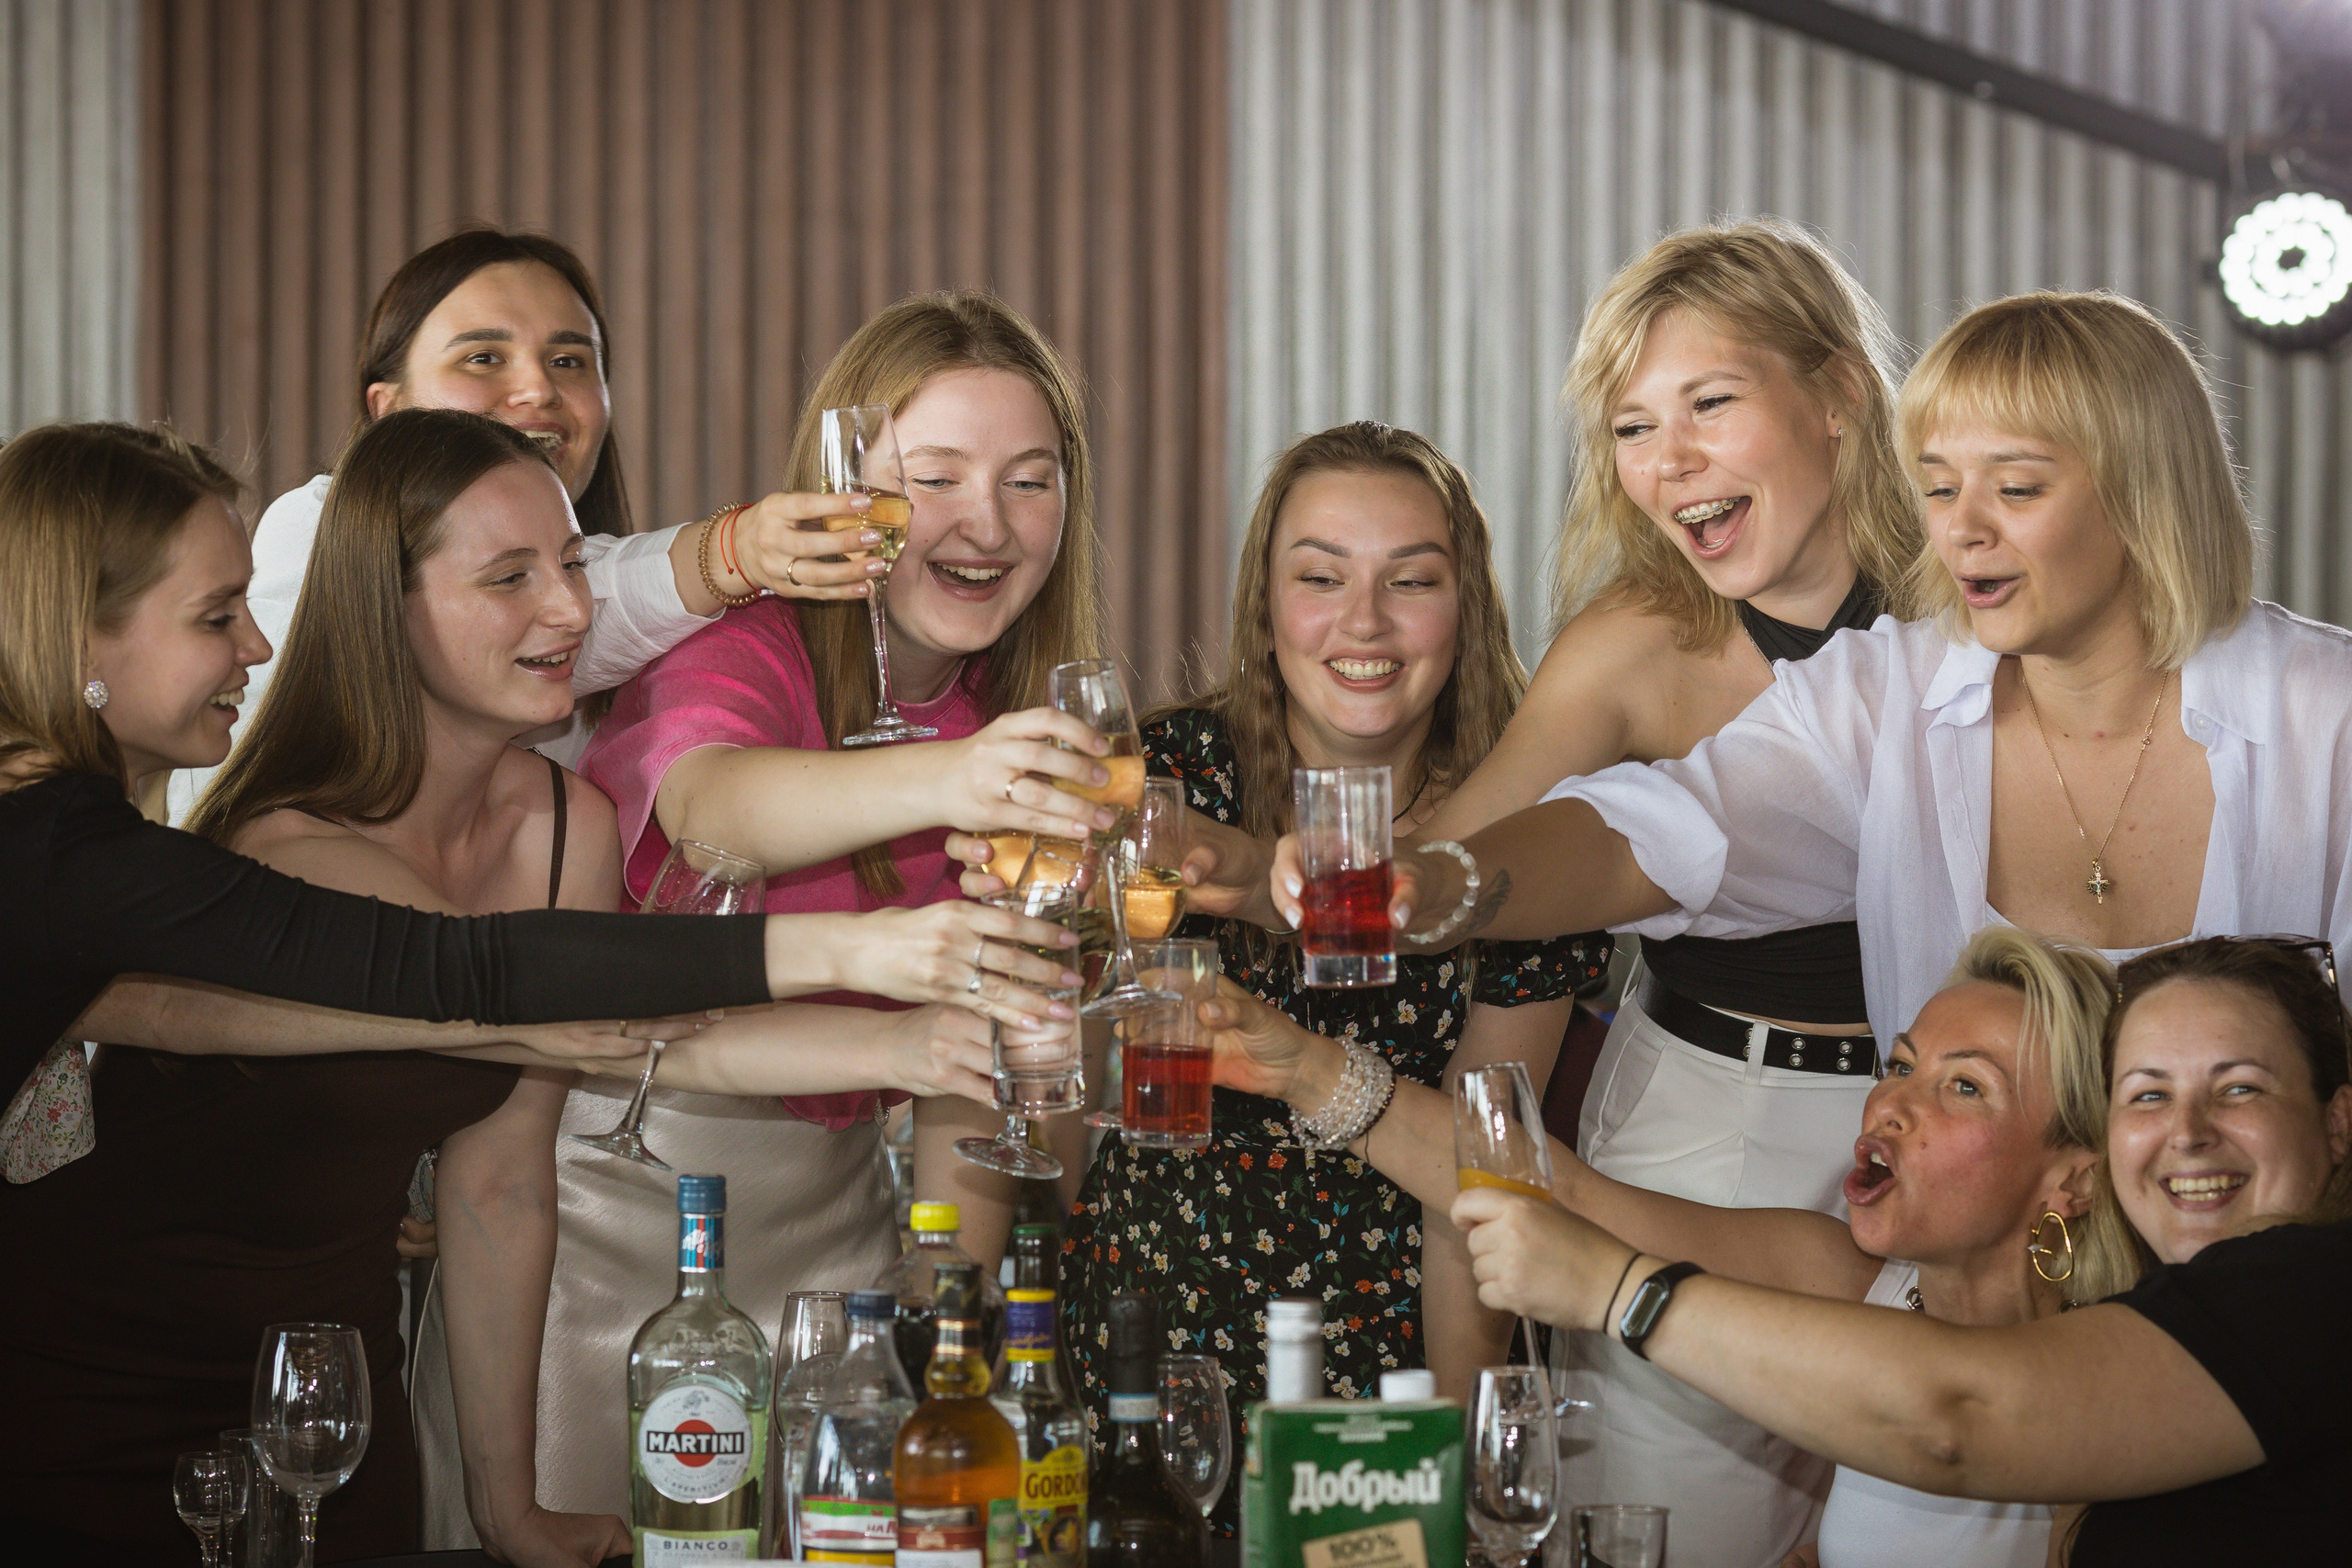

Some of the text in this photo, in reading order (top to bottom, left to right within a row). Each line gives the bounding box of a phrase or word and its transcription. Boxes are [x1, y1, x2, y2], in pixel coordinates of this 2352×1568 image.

[648, 1432, 742, 1453] MARTINI
[1288, 1456, 1442, 1515] Добрый
[663, 1540, 728, 1551] BIANCO
